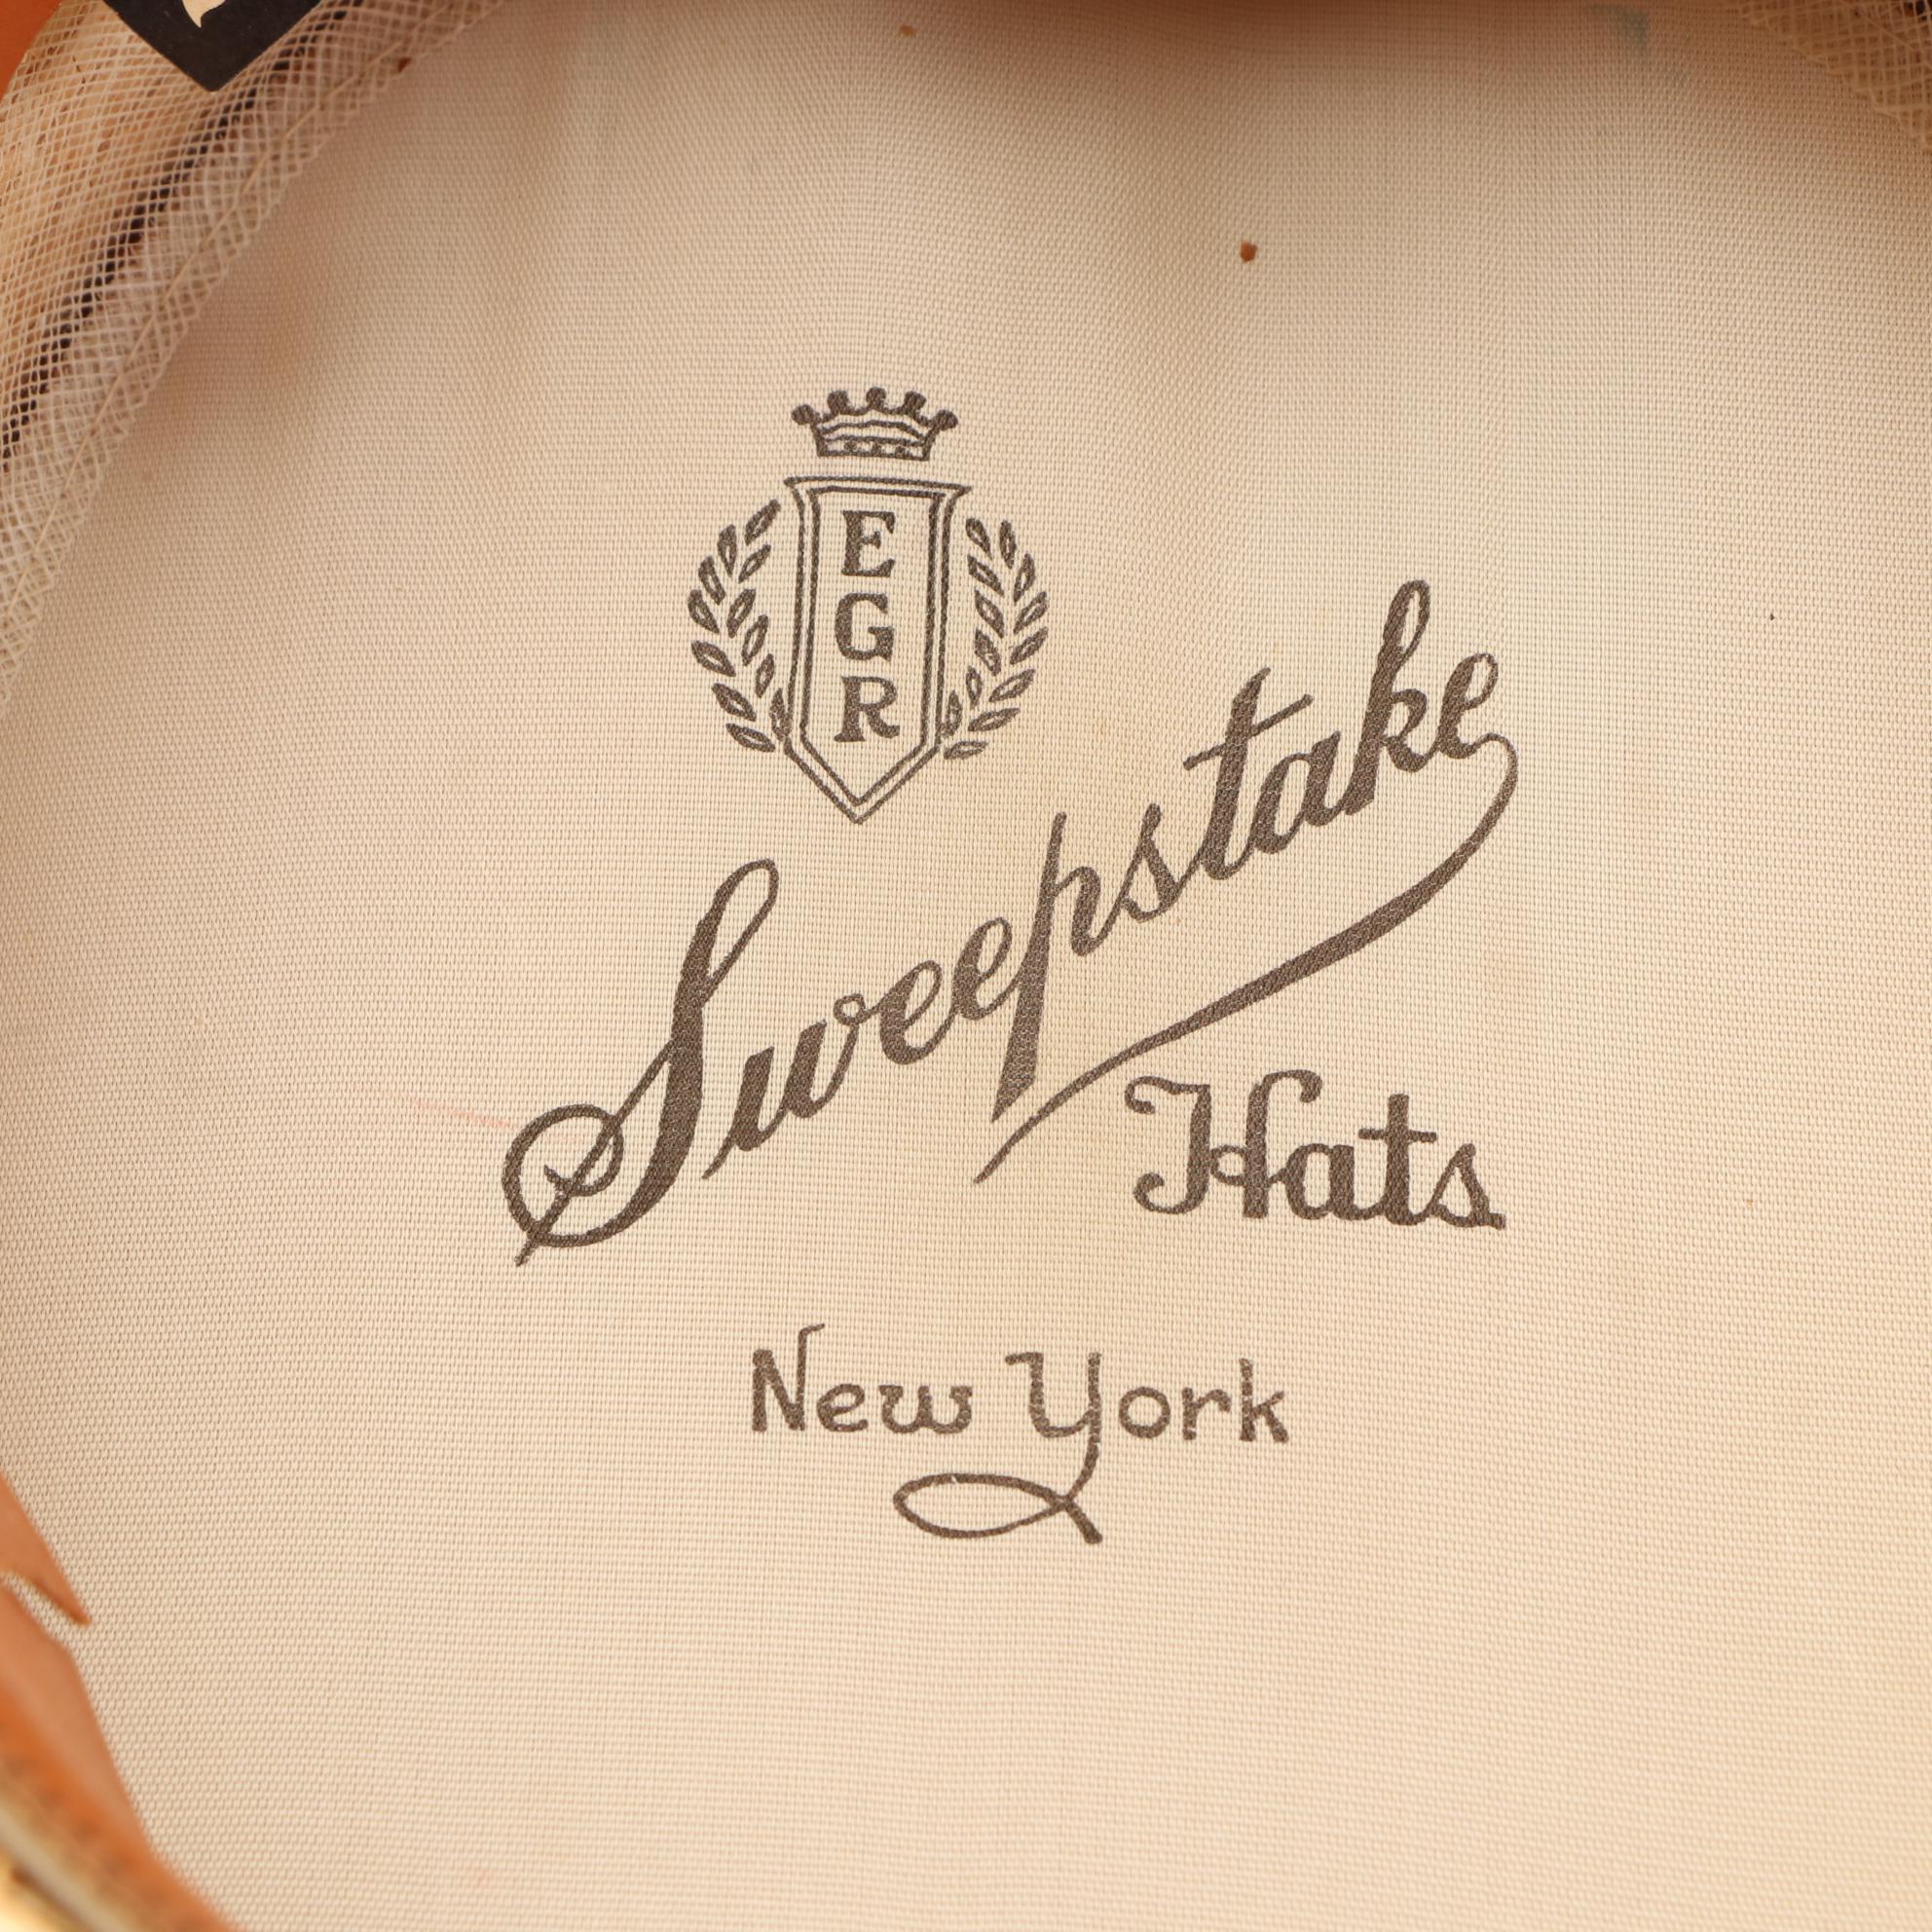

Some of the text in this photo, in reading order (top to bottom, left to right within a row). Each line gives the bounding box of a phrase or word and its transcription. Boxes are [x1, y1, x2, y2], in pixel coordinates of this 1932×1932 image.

[502, 578, 1518, 1266] Sweepstake
[1125, 1069, 1506, 1229] Hats
[753, 1324, 1288, 1545] New York
